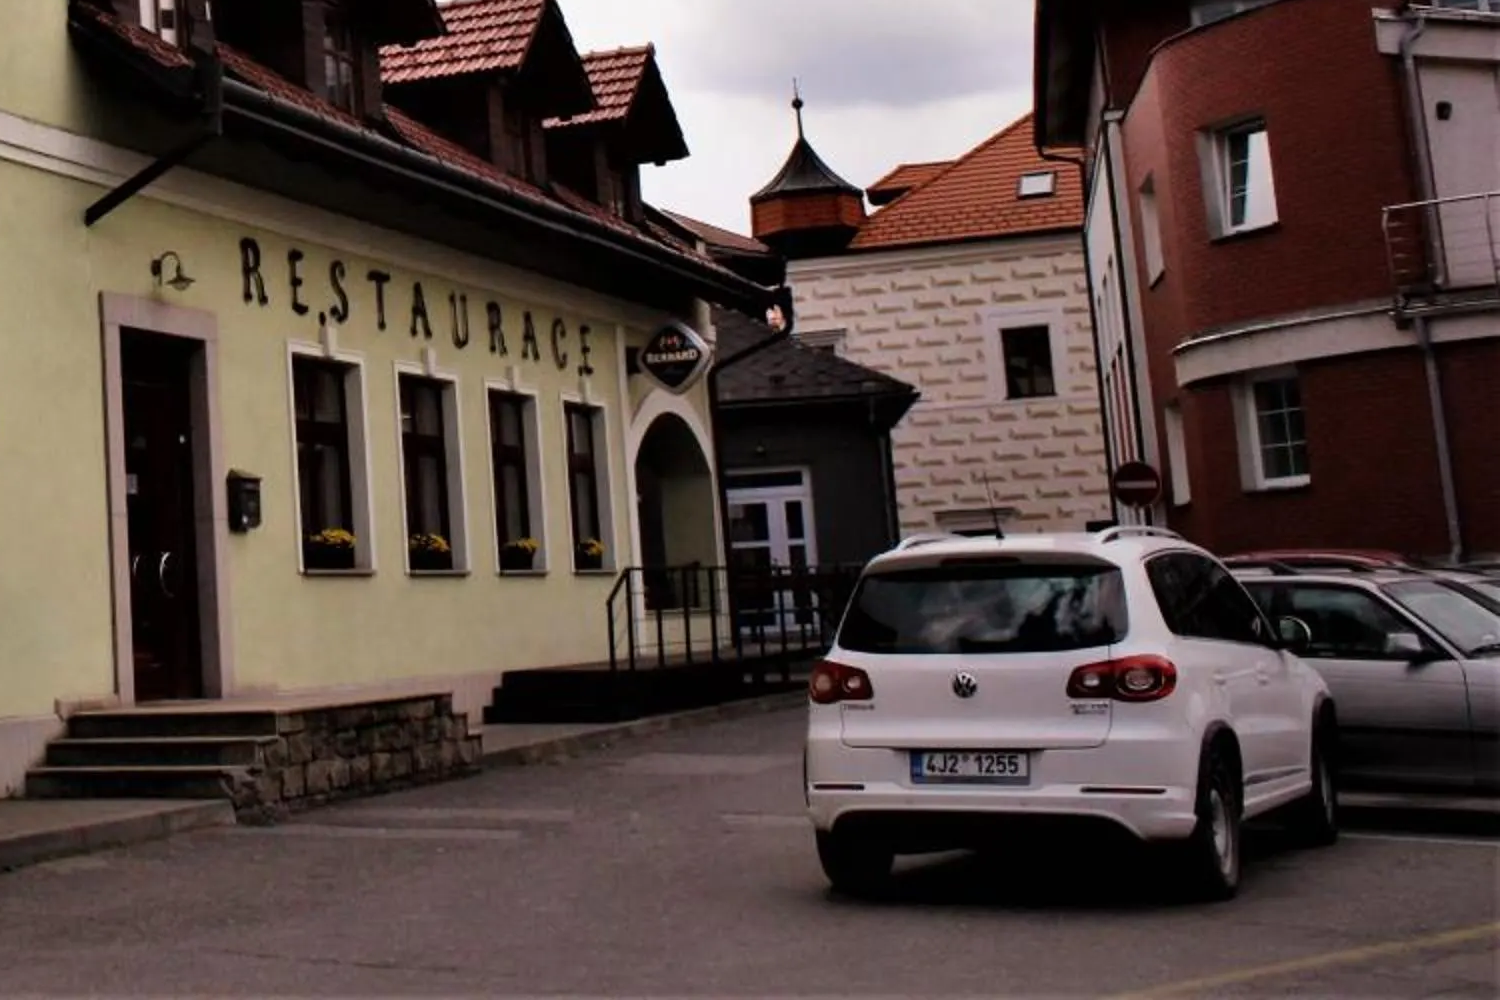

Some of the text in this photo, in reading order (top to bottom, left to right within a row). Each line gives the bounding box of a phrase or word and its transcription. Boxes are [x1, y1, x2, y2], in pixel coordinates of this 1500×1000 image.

[239, 237, 595, 376] RESTAURACE
[926, 754, 1019, 774] 4J2 1255
